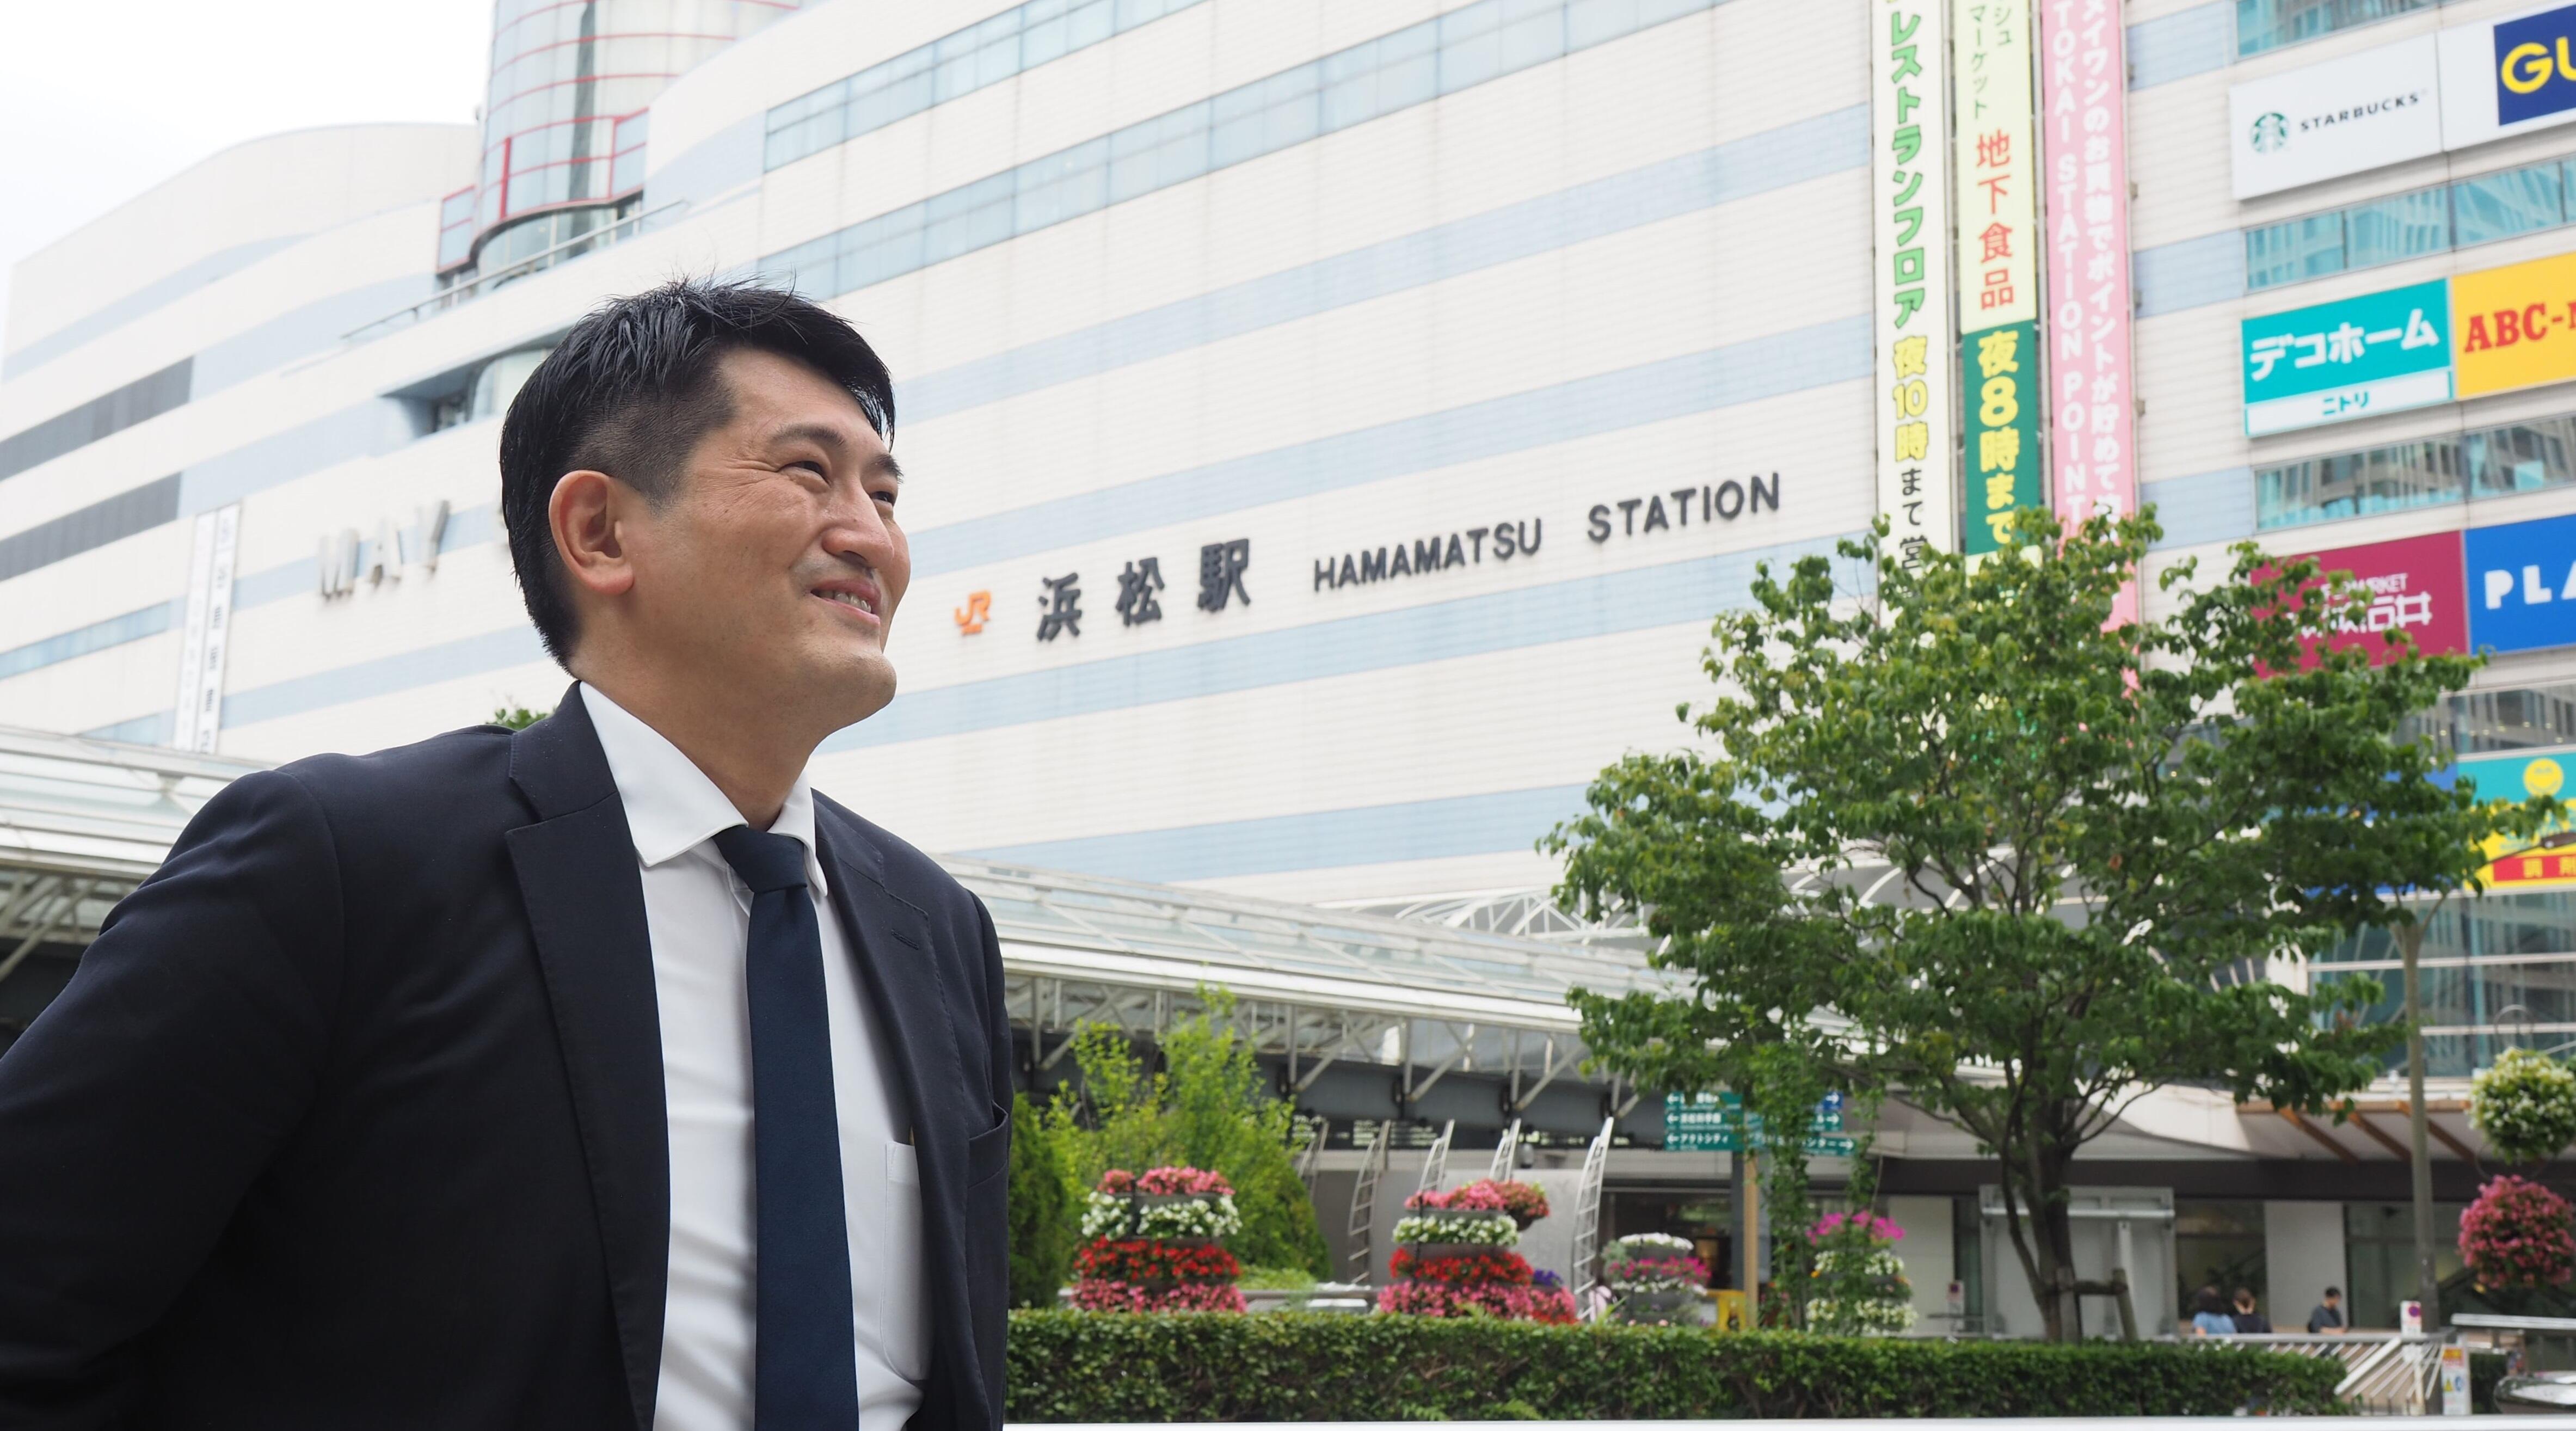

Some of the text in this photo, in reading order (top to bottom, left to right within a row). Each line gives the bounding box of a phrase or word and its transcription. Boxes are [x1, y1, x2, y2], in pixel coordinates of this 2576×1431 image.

[1970, 5, 1988, 119] マーケット
[2301, 92, 2419, 131] STARBUCKS
[1891, 11, 1925, 329] レストランフロア
[1976, 129, 2014, 310] 地下食品
[2052, 1, 2088, 525] TOKAI STATION POINT
[2249, 308, 2439, 381] デコホーム
[2322, 391, 2369, 415] ニトリ
[1977, 330, 2020, 544] 夜8時まで
[1036, 538, 1251, 642] 浜松駅
[1314, 472, 1780, 593] HAMAMATSU STATION
